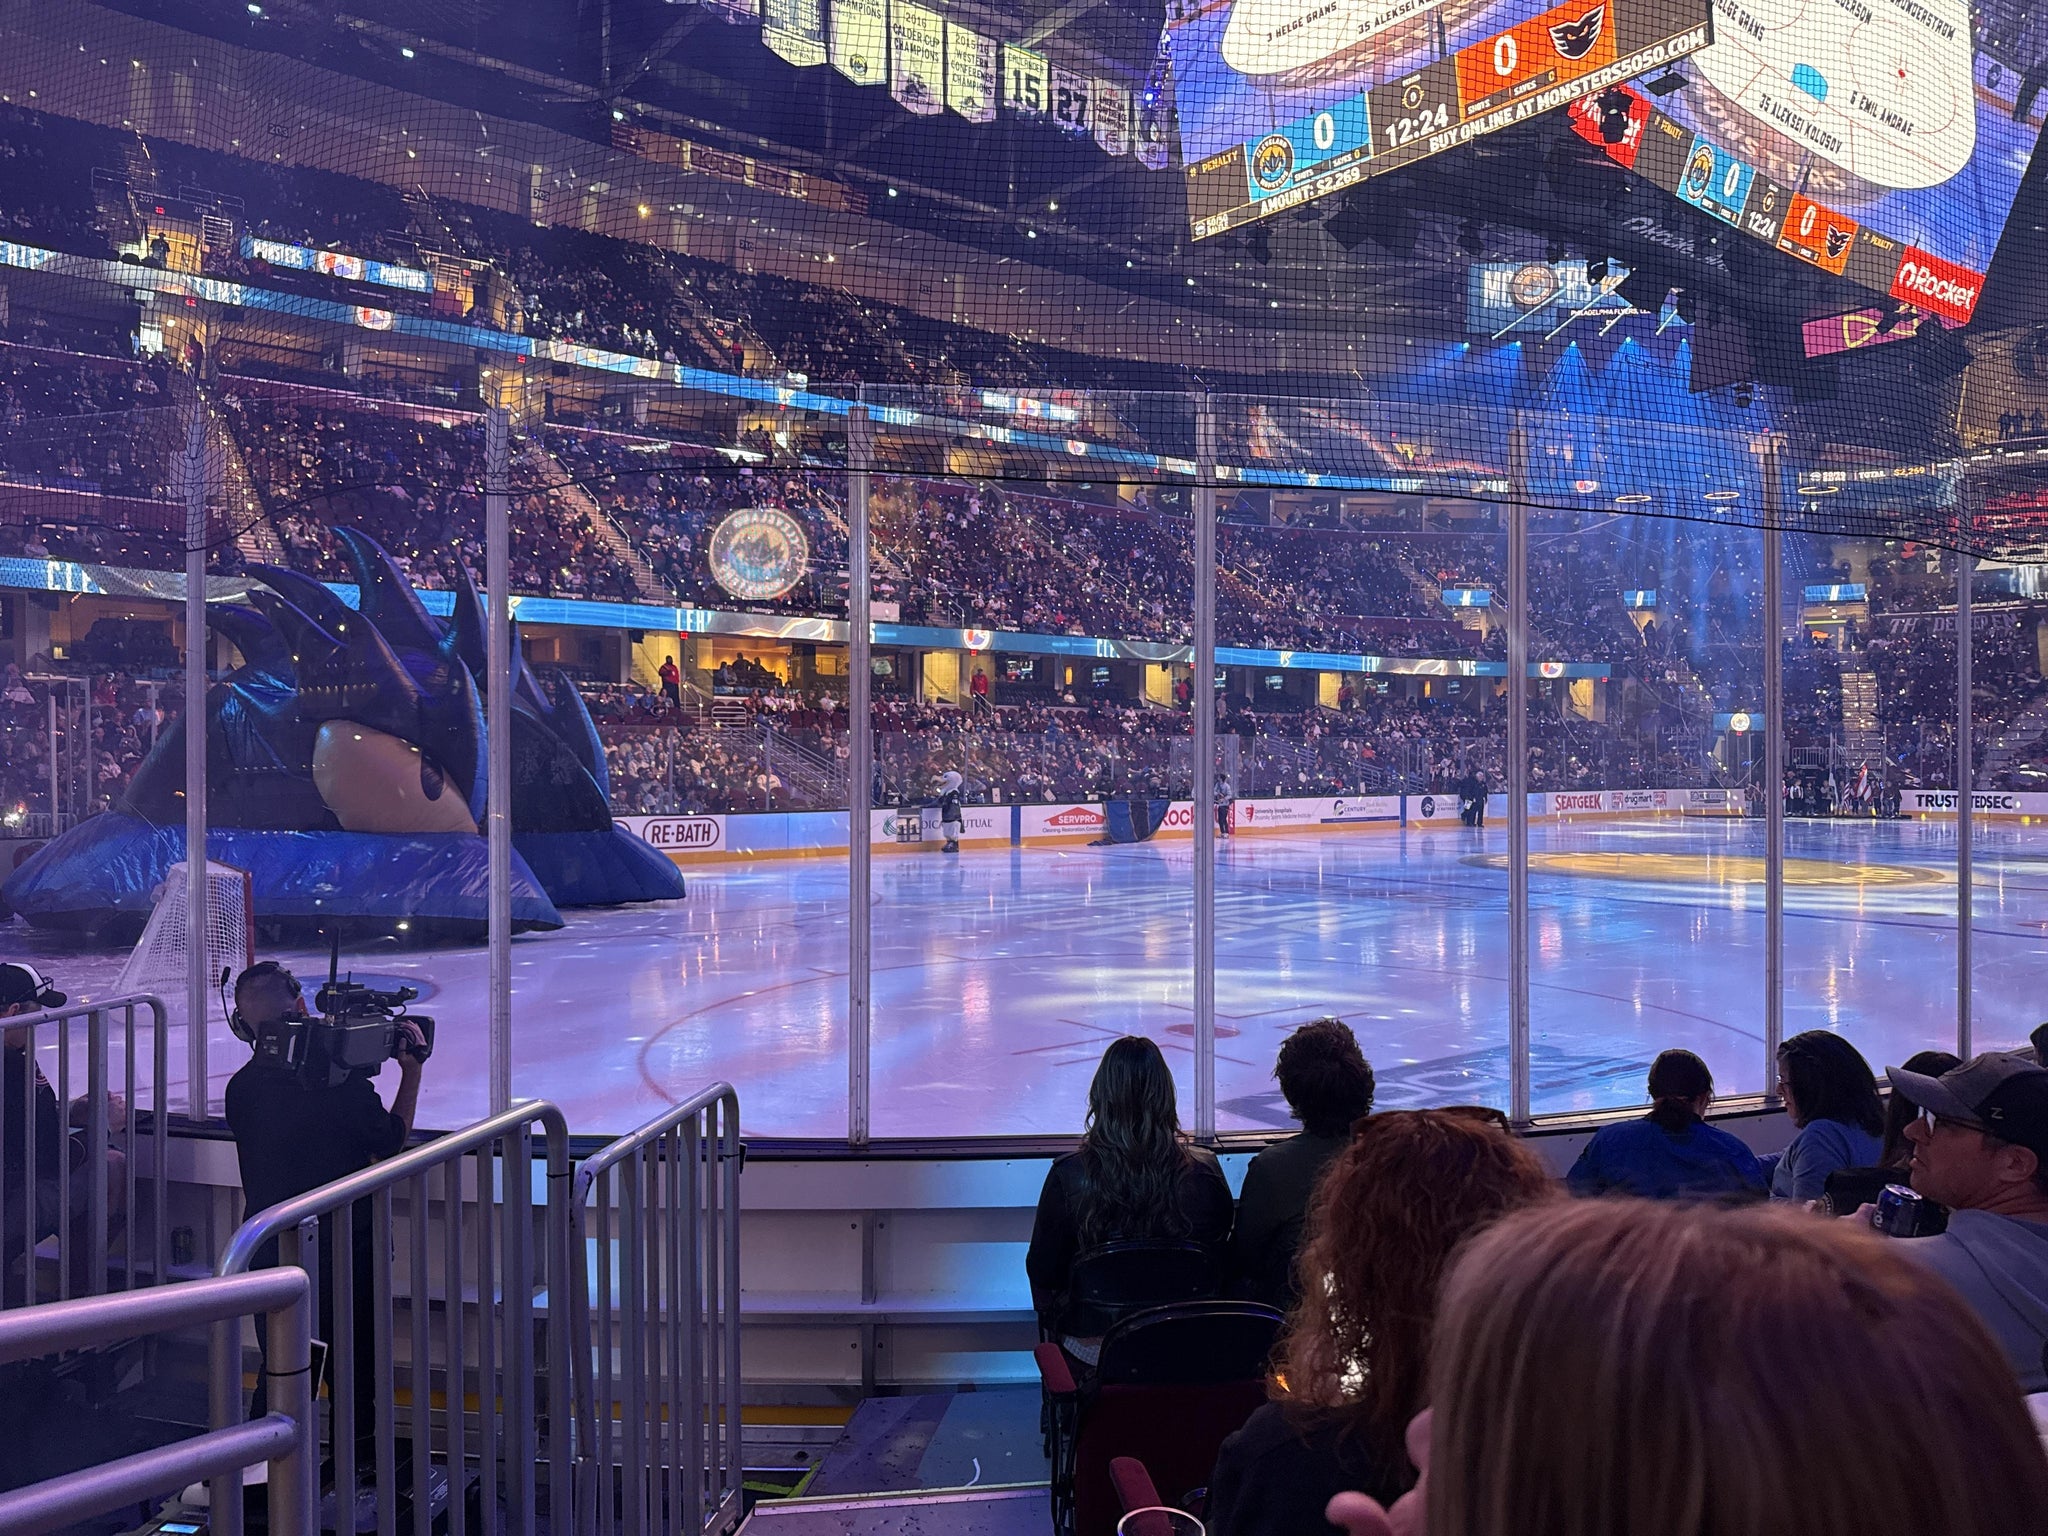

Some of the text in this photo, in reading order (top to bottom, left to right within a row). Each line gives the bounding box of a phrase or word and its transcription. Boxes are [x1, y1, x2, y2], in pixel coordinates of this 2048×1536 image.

[905, 12, 927, 28] 2016
[1267, 3, 1337, 43] 3 HELGE GRANS
[1357, 19, 1371, 35] 35
[1374, 1, 1416, 28] ALEKSEI
[1738, 9, 1765, 42] GRANS
[893, 23, 940, 48] CALDER CUP
[894, 37, 939, 63] CHAMPIONS
[956, 50, 989, 67] WESTERN
[1494, 34, 1517, 76] 0
[951, 60, 994, 84] CONFERENCE
[952, 73, 992, 95] CHAMPIONS
[1012, 69, 1041, 110] 15
[1429, 27, 1707, 153] BUY ONLINE AT MONSTERS5050.COM
[1057, 86, 1088, 127] 27
[1859, 95, 1878, 118] EMIL
[1879, 108, 1914, 137] ANDRAE
[1313, 112, 1335, 150] 0
[1386, 103, 1449, 148] 12:24
[1758, 93, 1843, 155] 35 ALEKSEI KOLOSOV
[1202, 150, 1238, 173] PENALTY
[1723, 162, 1741, 197] 0
[1260, 184, 1314, 215] AMOUNT:
[1749, 211, 1777, 239] 12:24
[1800, 205, 1818, 236] 0
[1556, 793, 1601, 811] SEATGEEK
[1624, 794, 1652, 805] drug mart
[961, 819, 992, 828] UTUAL
[1058, 815, 1097, 824] SERVPRO
